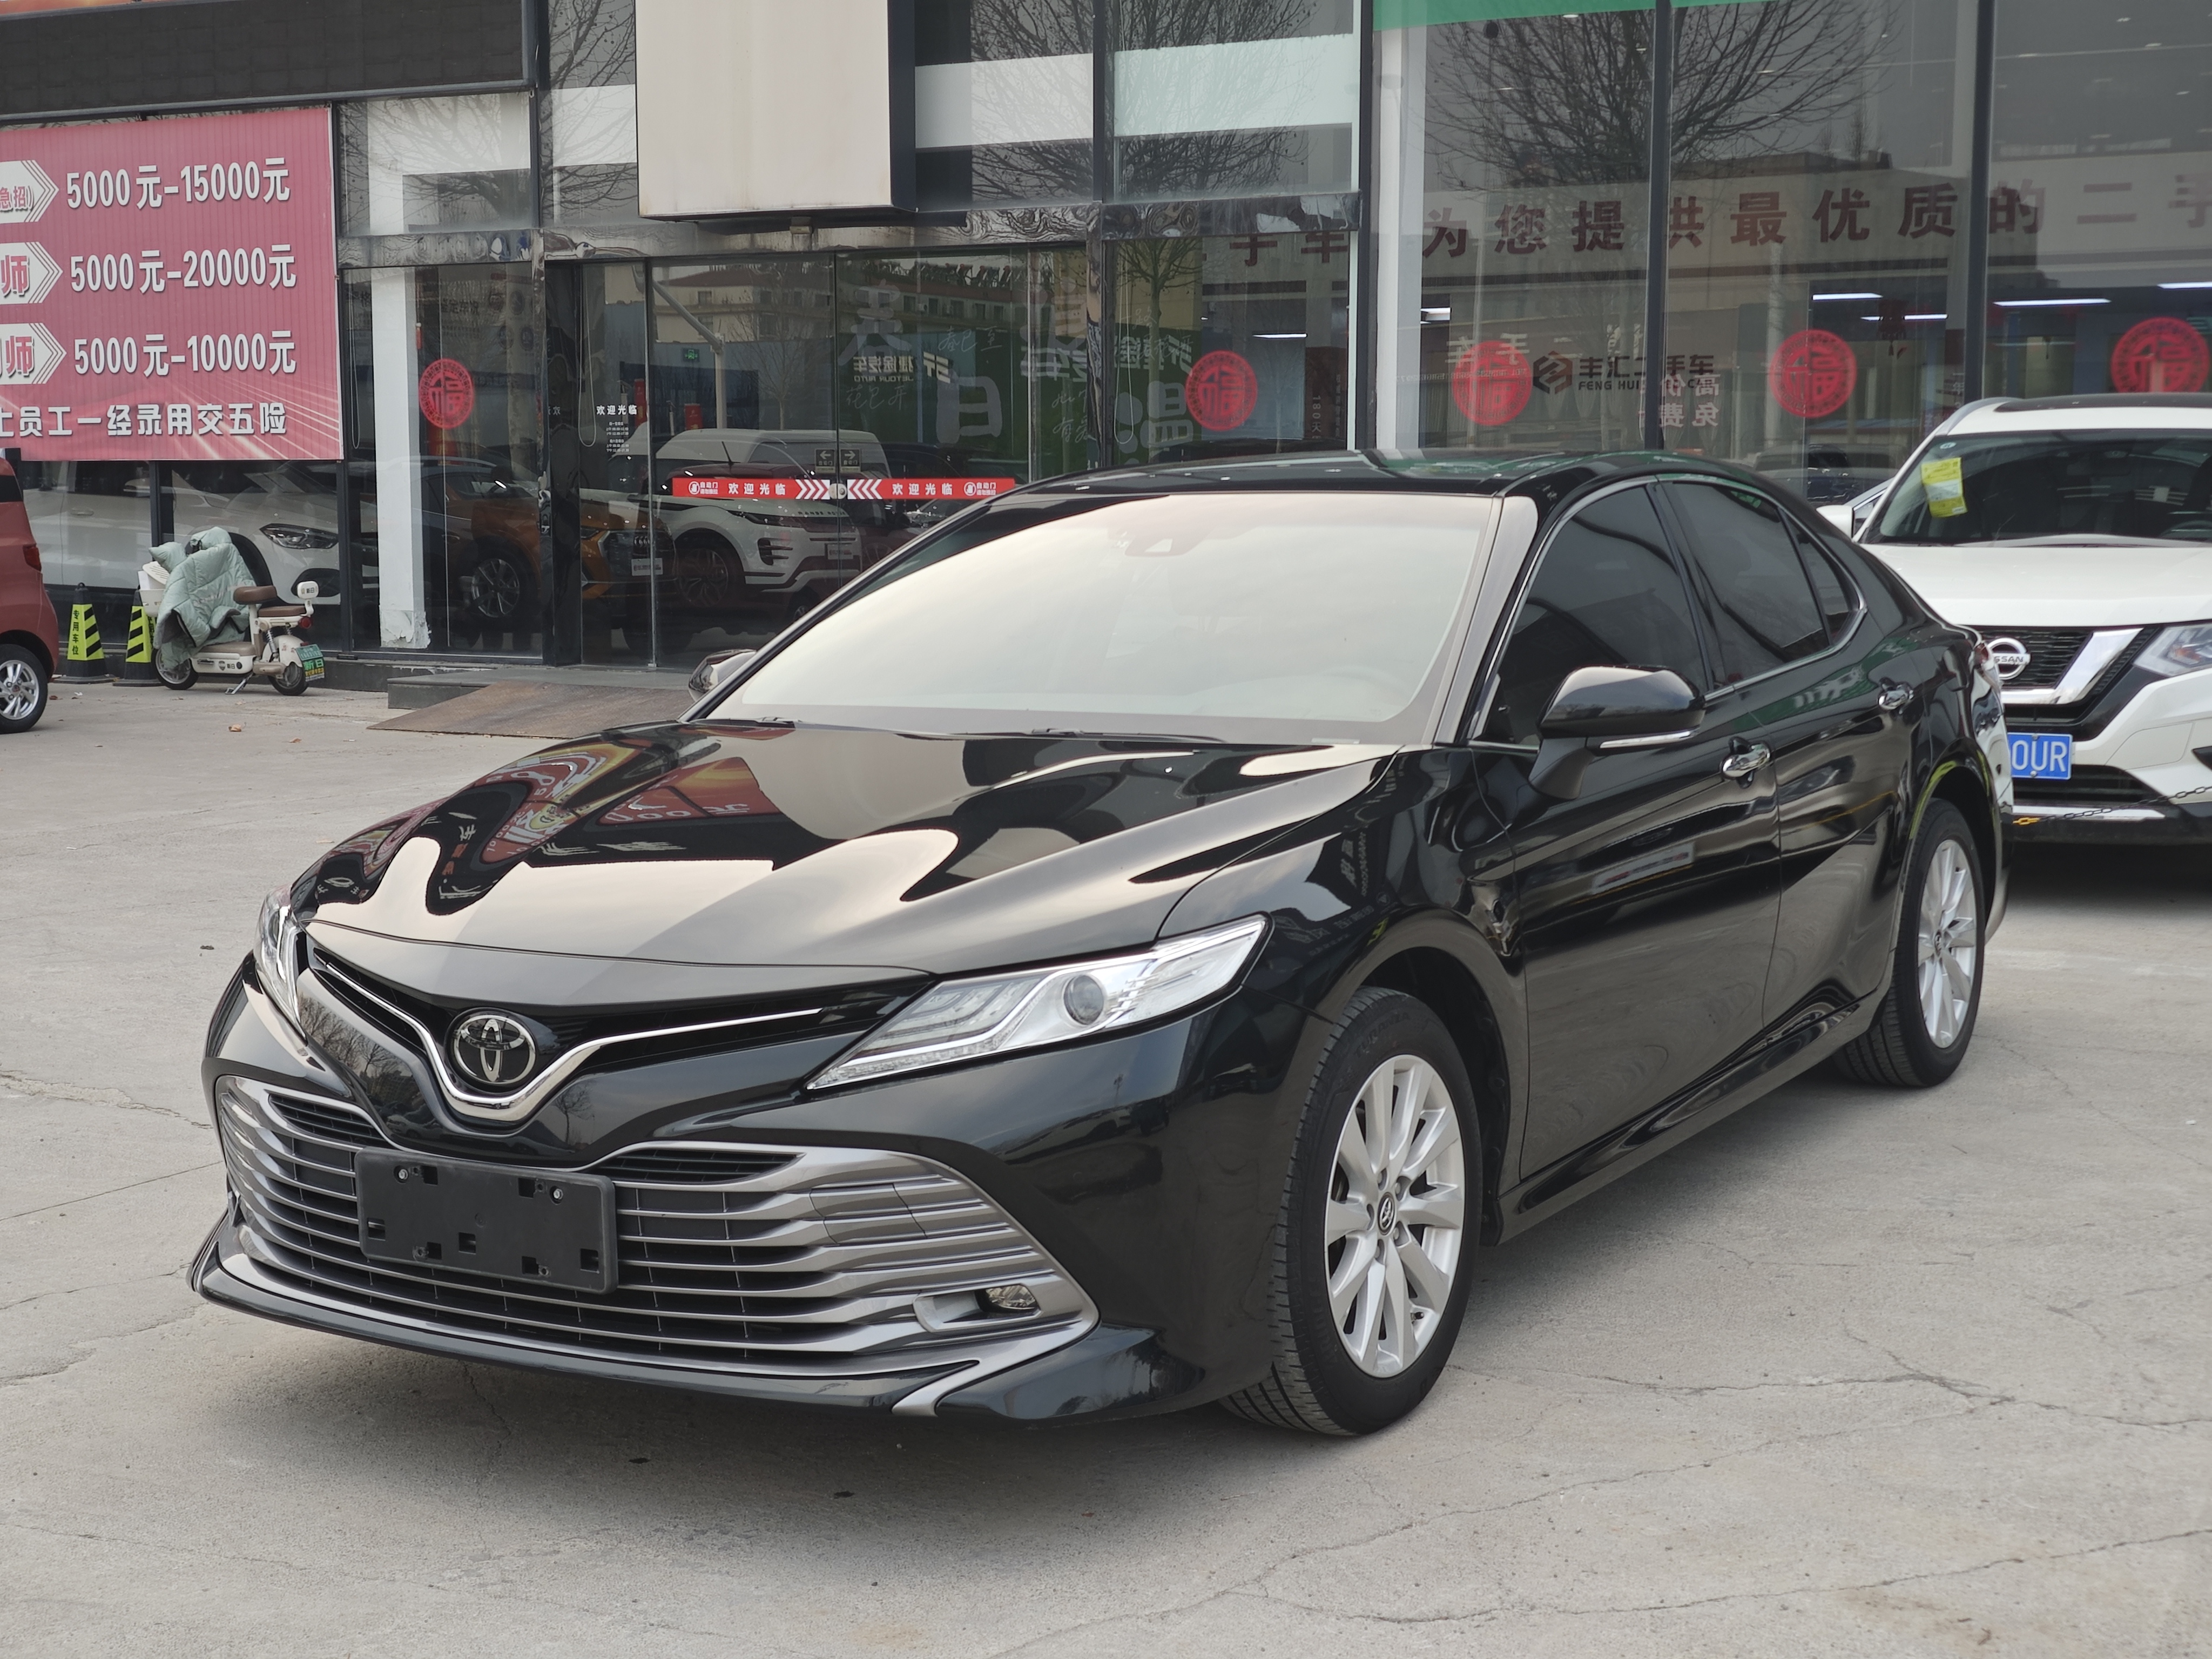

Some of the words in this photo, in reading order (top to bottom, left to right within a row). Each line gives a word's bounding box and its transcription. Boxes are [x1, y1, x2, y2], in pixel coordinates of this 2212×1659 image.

[66, 157, 291, 210] 5000元-15000元
[70, 244, 296, 294] 5000元-20000元
[0, 335, 34, 377] 师
[74, 330, 296, 377] 5000元-10000元
[1578, 380, 1613, 390] FENG
[1618, 380, 1640, 390] HUI
[596, 404, 638, 416] 欢迎光临
[728, 482, 786, 495] 欢迎光临
[892, 483, 953, 496] 欢迎光临
[72, 610, 80, 655] 专用车位
[2012, 739, 2069, 772] OUR
